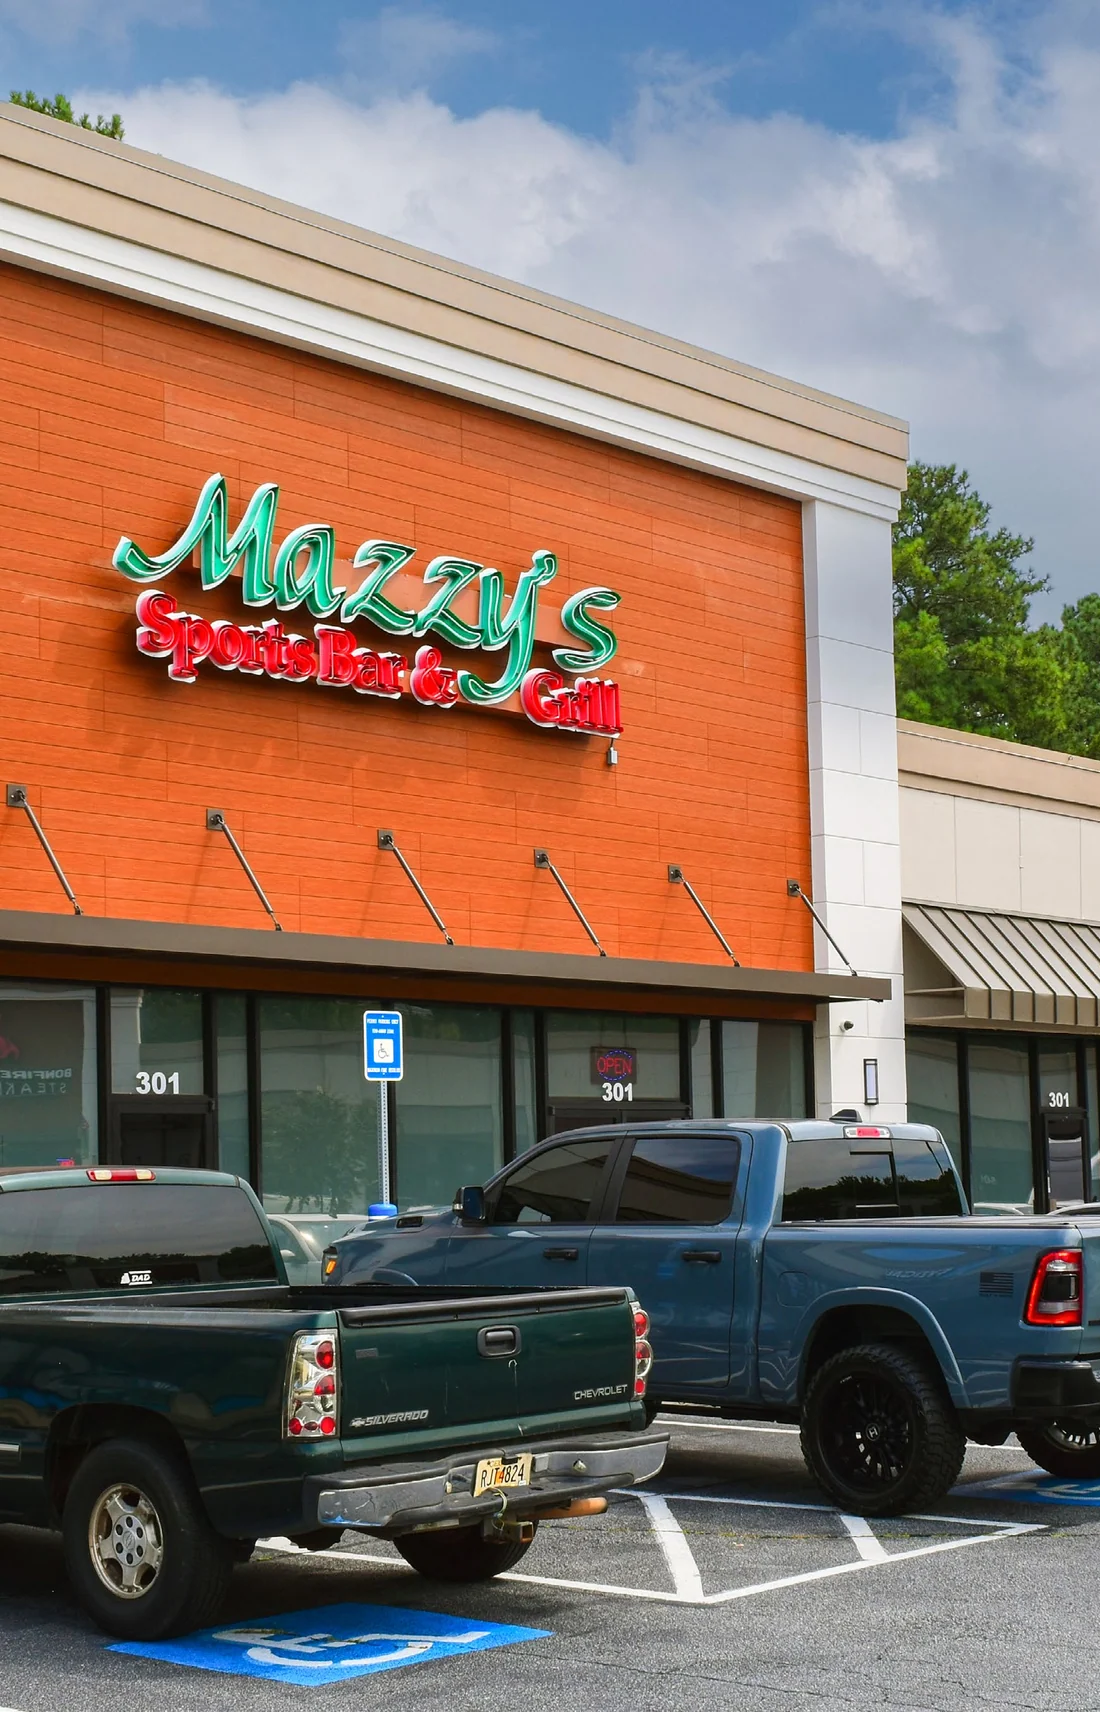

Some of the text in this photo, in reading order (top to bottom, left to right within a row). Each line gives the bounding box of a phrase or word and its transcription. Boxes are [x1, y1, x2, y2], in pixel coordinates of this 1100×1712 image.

[112, 471, 622, 704] Mazzy's
[135, 588, 624, 738] Sports Bar & Grill
[596, 1057, 633, 1075] OPEN
[135, 1071, 180, 1095] 301
[602, 1082, 633, 1102] 301
[1048, 1092, 1070, 1108] 301
[131, 1273, 151, 1282] DAD
[573, 1384, 628, 1400] CHEVROLET
[364, 1409, 429, 1426] SILVERADO
[481, 1463, 525, 1487] RJT4824
